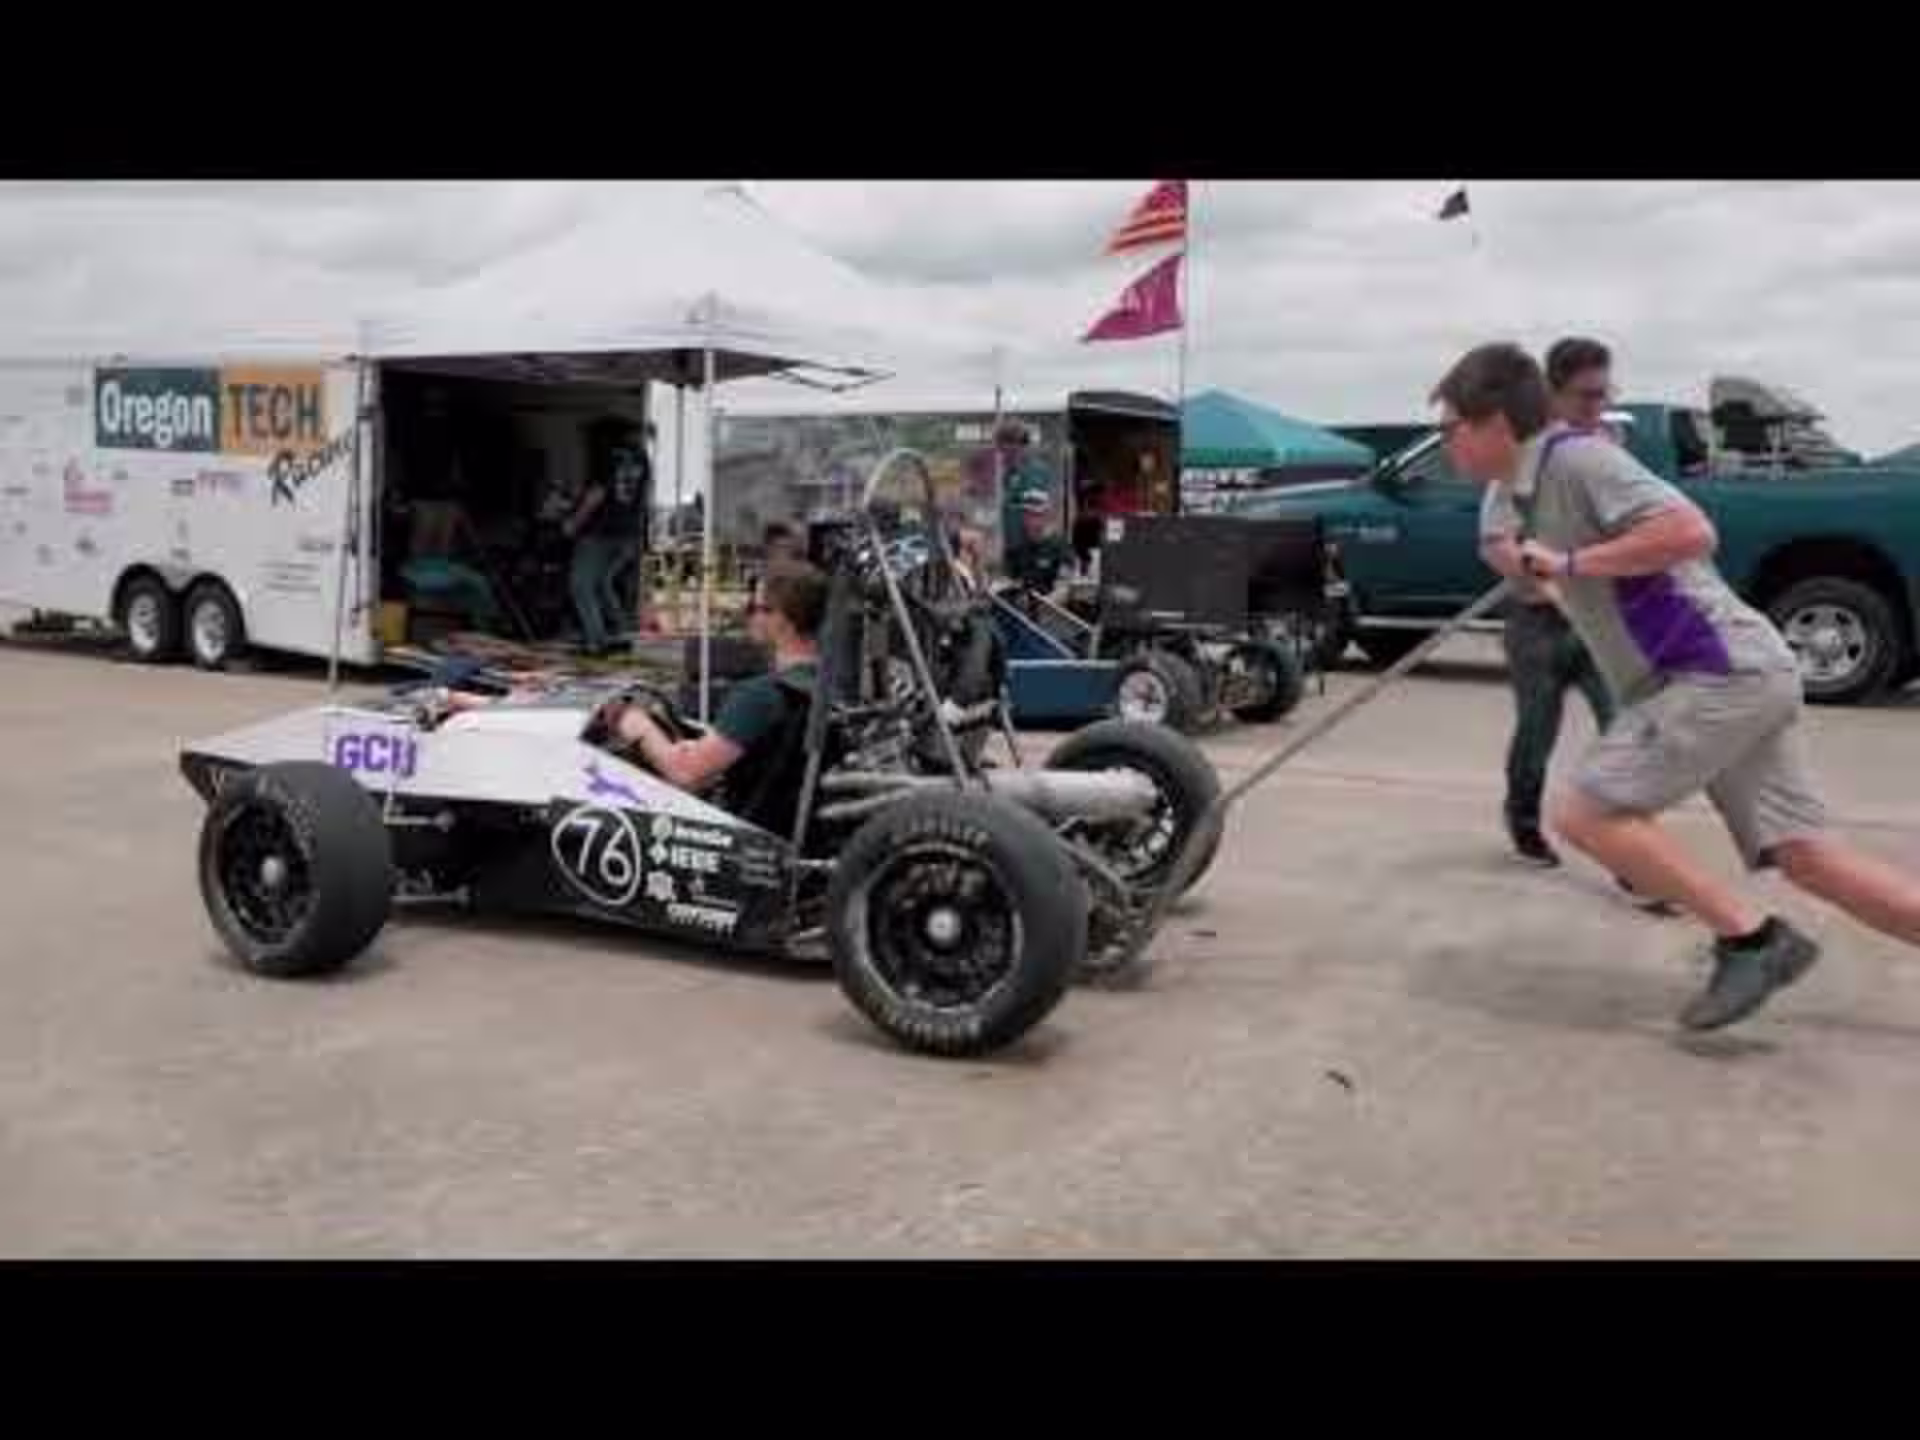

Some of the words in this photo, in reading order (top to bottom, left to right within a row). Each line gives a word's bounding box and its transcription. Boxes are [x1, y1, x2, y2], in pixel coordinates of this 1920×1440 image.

[100, 382, 213, 447] Oregon
[226, 384, 321, 441] TECH
[568, 816, 634, 887] 76
